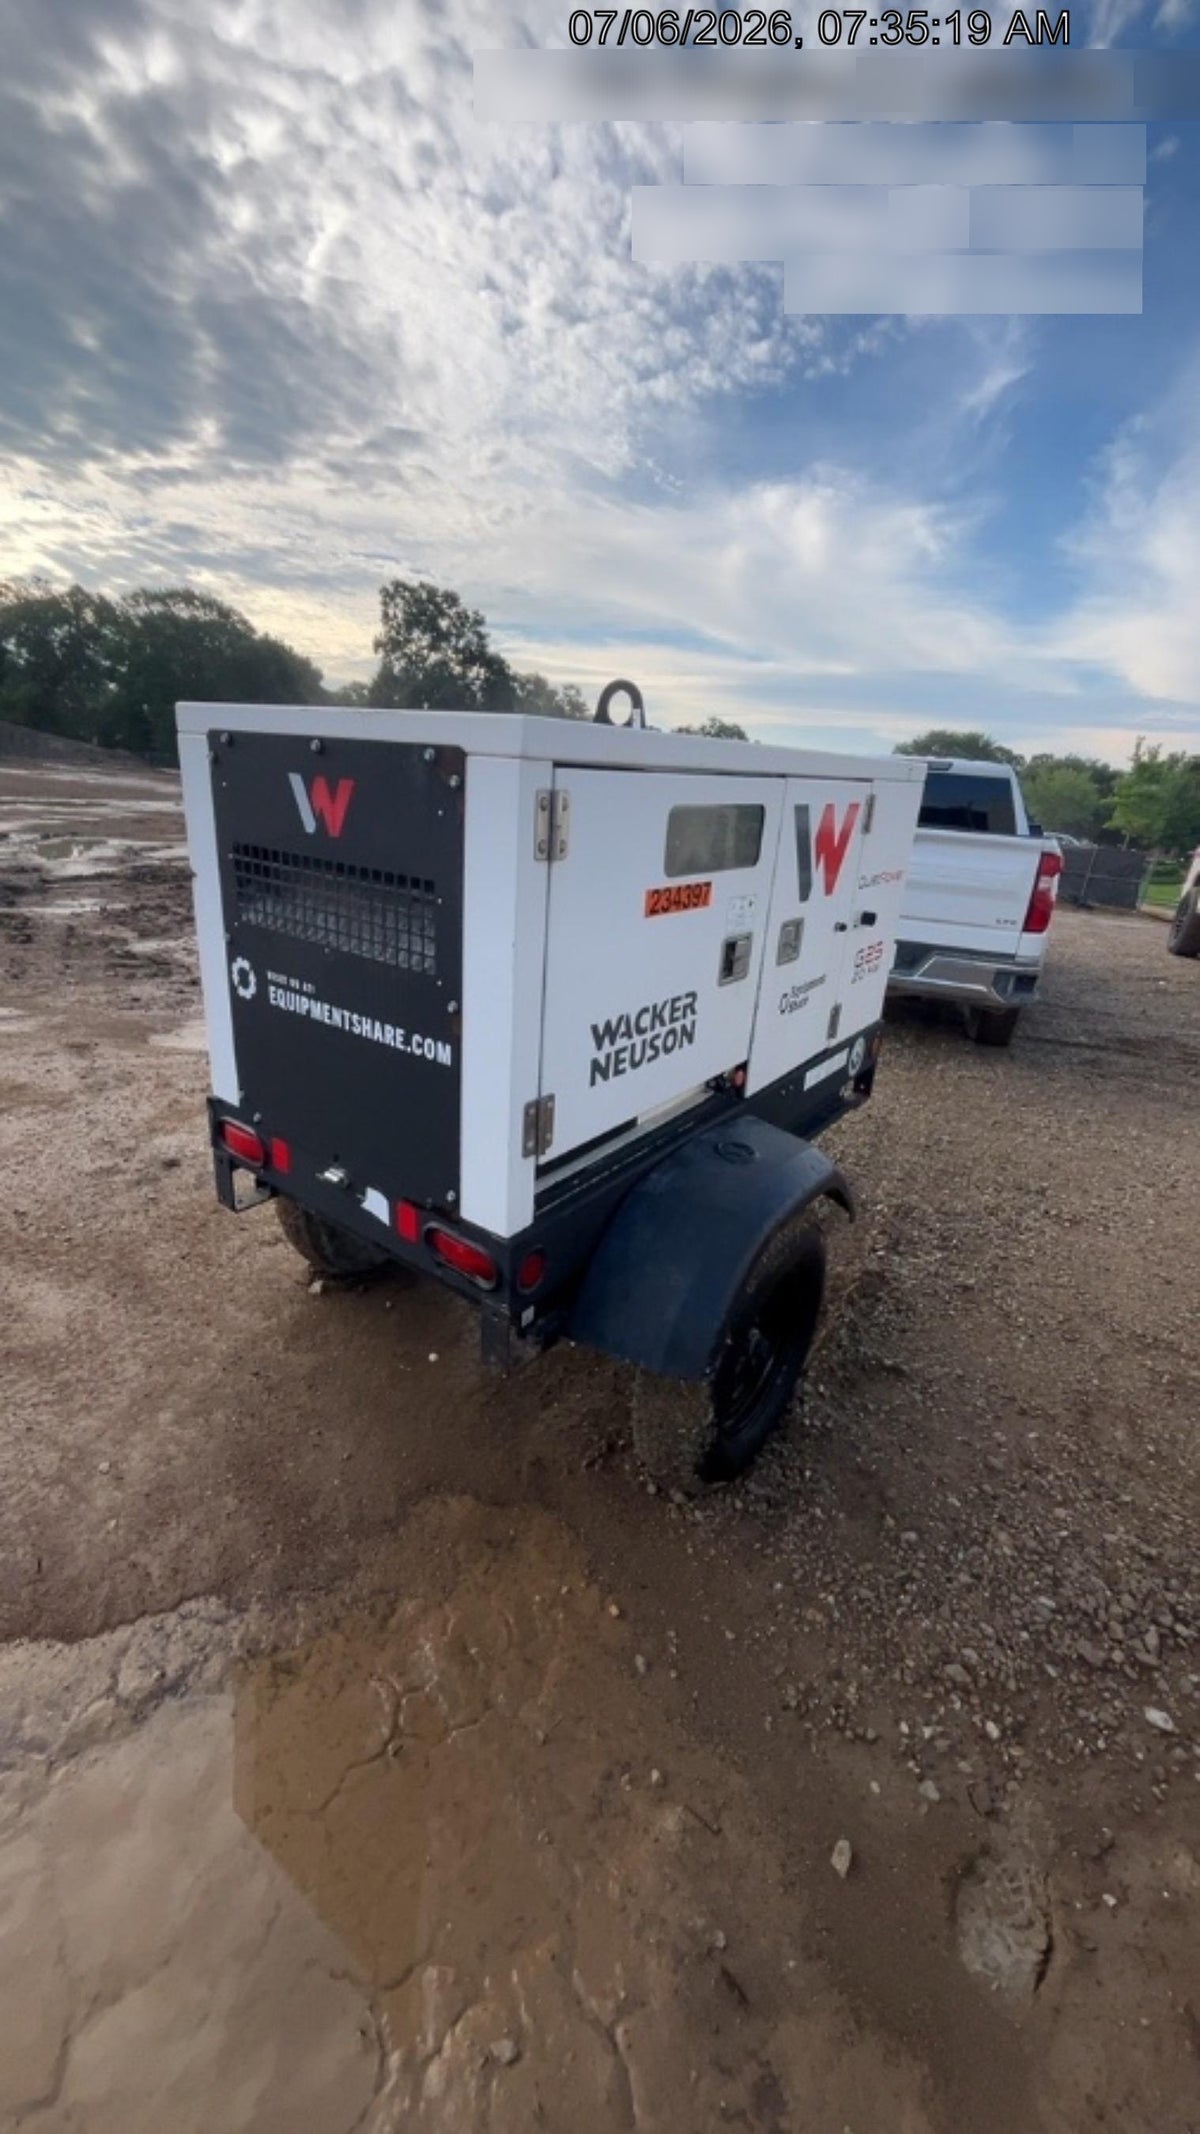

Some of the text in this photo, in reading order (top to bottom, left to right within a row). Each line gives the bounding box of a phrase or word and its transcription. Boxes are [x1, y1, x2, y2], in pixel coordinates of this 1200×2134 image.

[649, 881, 712, 915] 234397
[268, 985, 452, 1066] EQUIPMENTSHARE.COM
[590, 990, 699, 1051] WACKER
[589, 1019, 698, 1088] NEUSON
